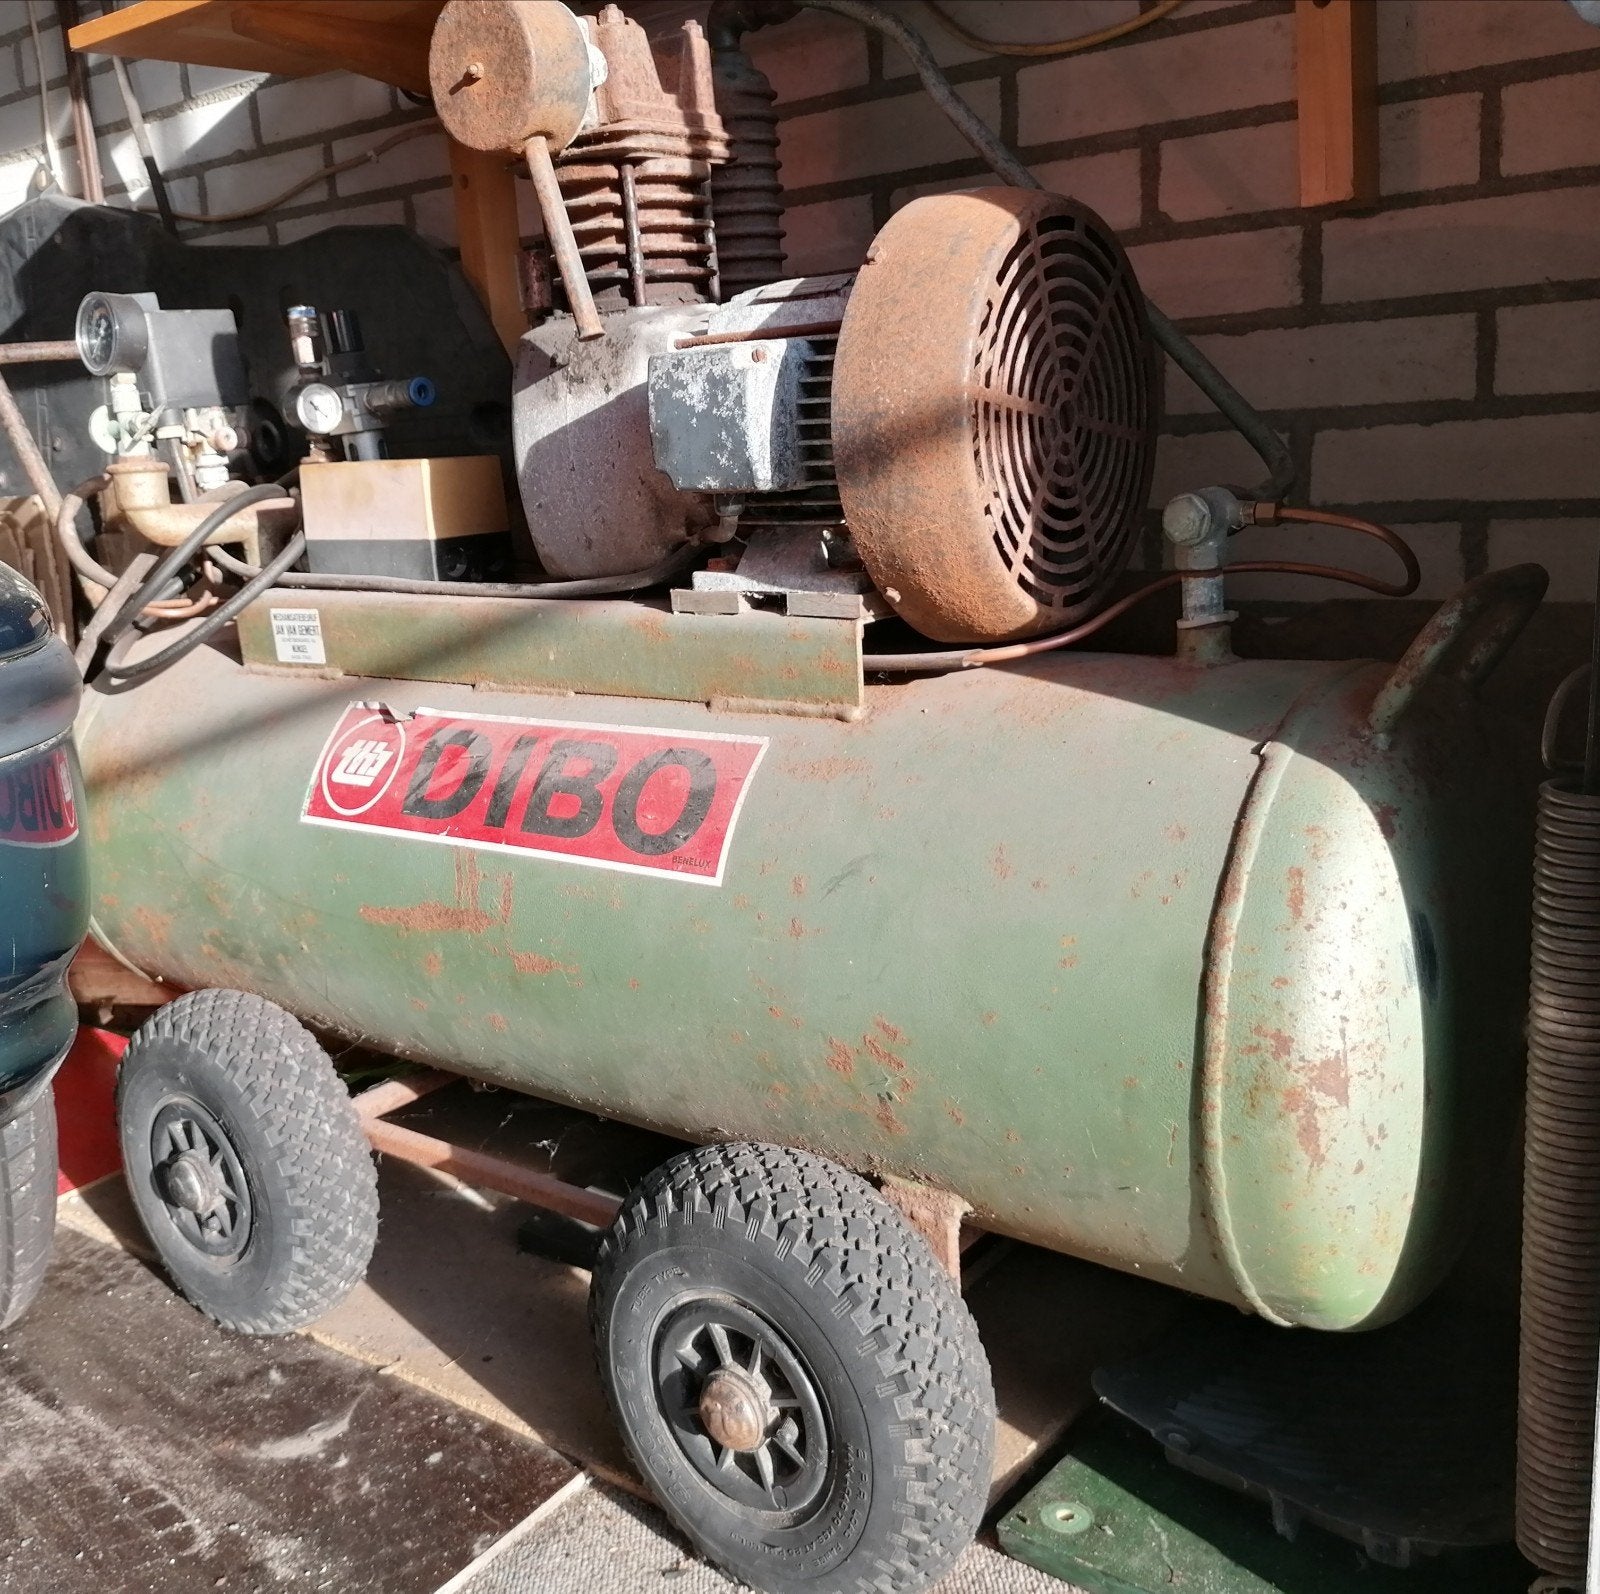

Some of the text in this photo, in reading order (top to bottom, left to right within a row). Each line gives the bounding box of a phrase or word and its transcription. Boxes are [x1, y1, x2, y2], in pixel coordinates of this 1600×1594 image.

[402, 727, 718, 856] DIBO
[672, 855, 711, 869] BENELUX
[630, 1266, 685, 1312] TUBE TYPE
